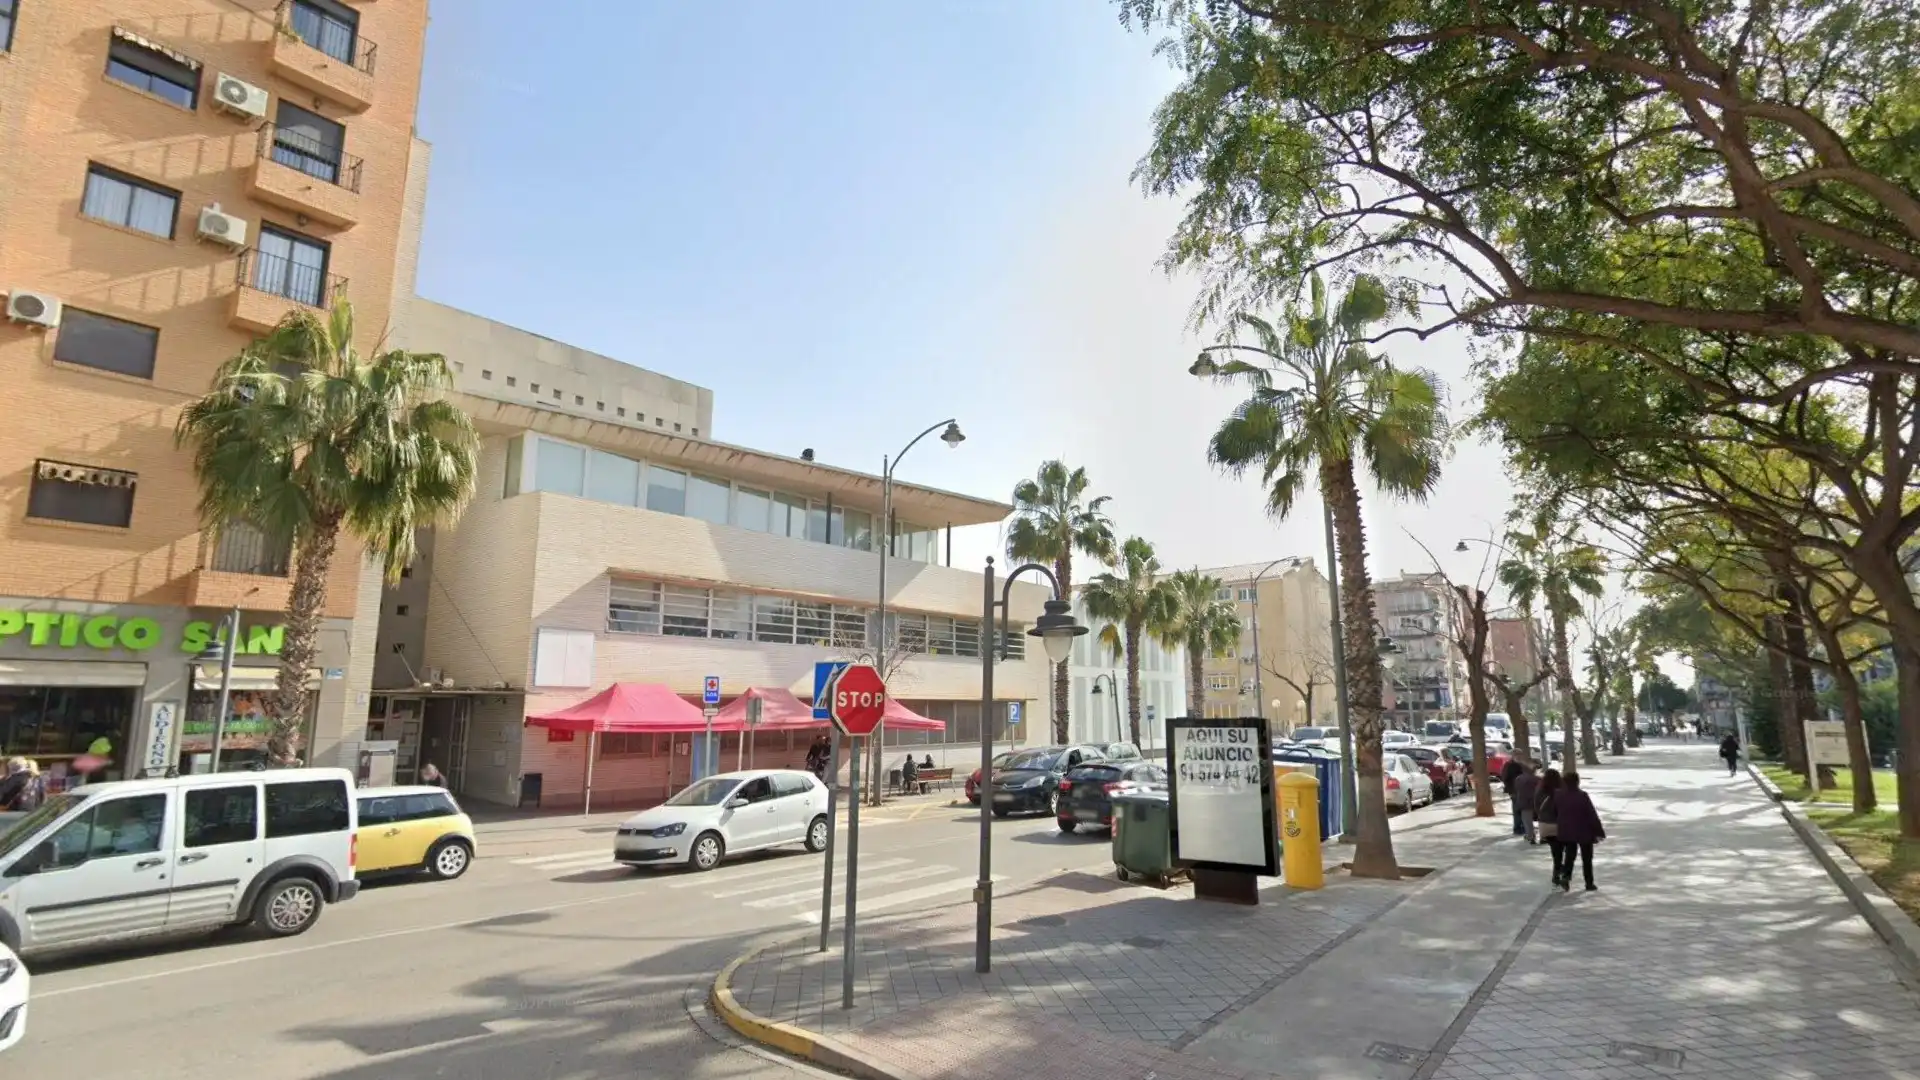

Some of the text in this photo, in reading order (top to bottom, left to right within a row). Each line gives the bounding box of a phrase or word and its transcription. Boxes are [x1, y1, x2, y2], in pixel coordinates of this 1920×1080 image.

[838, 691, 884, 708] STOP
[1187, 728, 1249, 743] AQUI SU
[1184, 746, 1253, 762] ANUNCIO
